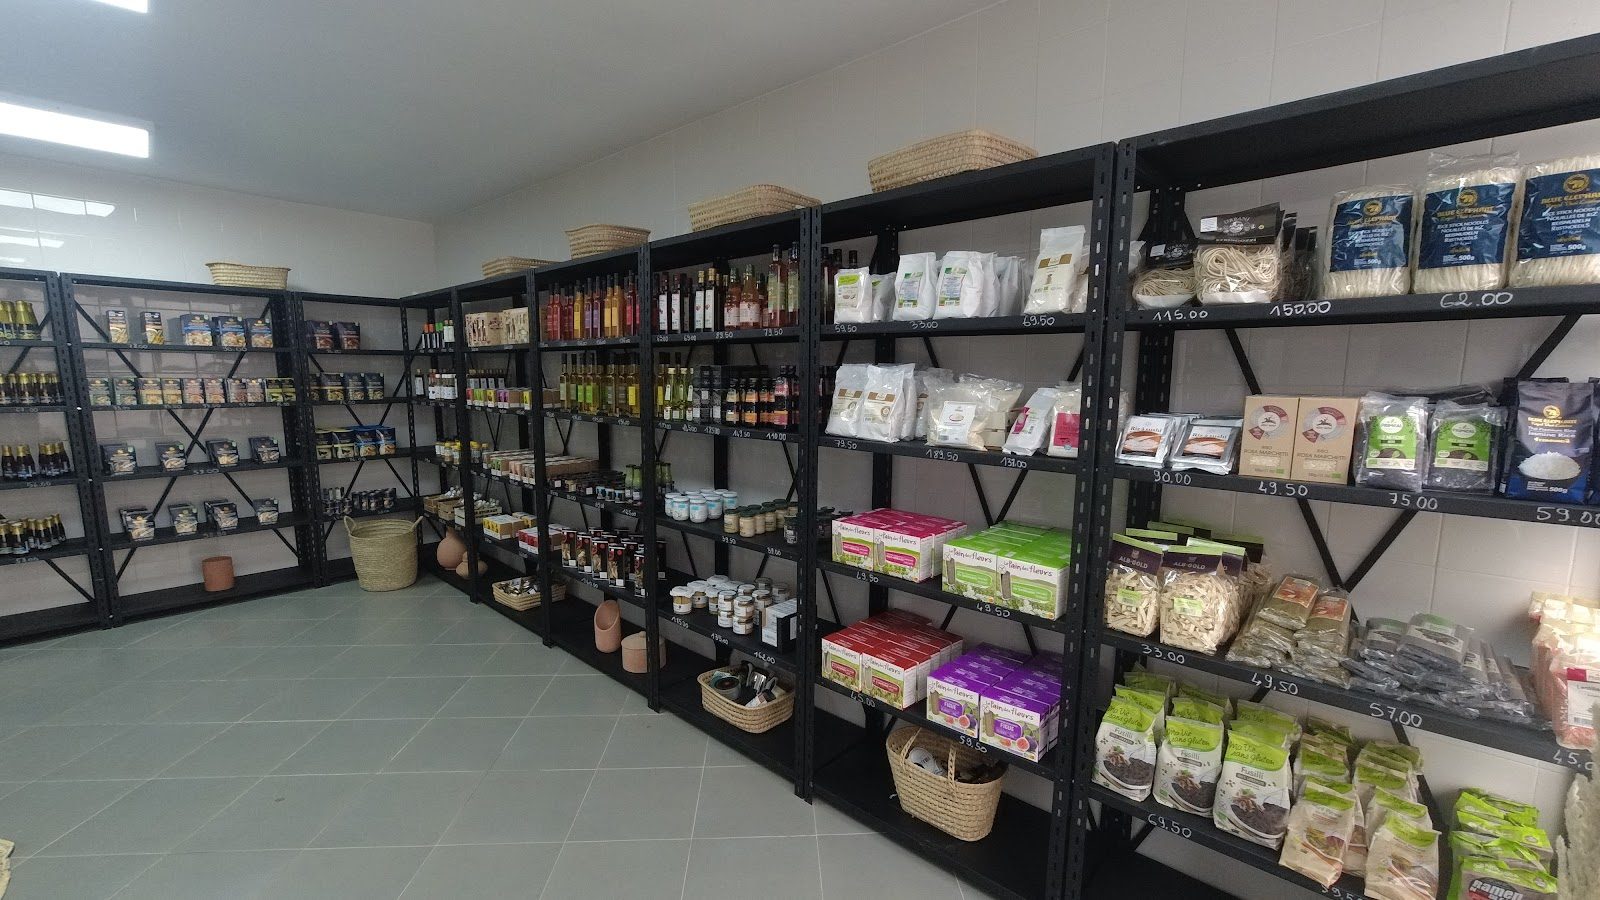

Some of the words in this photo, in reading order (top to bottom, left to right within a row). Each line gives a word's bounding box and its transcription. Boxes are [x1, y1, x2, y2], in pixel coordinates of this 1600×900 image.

[1440, 291, 1513, 308] 62.00
[1153, 310, 1208, 321] 115.00
[1269, 301, 1331, 316] 150.00
[1153, 469, 1192, 485] 90.00
[1258, 480, 1309, 497] 49.50
[972, 552, 992, 563] fleurs
[1029, 566, 1053, 577] fleurs
[1140, 643, 1185, 664] 33.00
[1251, 672, 1299, 695] 49.50
[1012, 708, 1034, 721] fleurs
[1369, 702, 1423, 727] 57.00
[1241, 766, 1265, 780] Fusilli
[1148, 813, 1192, 838] 69.50
